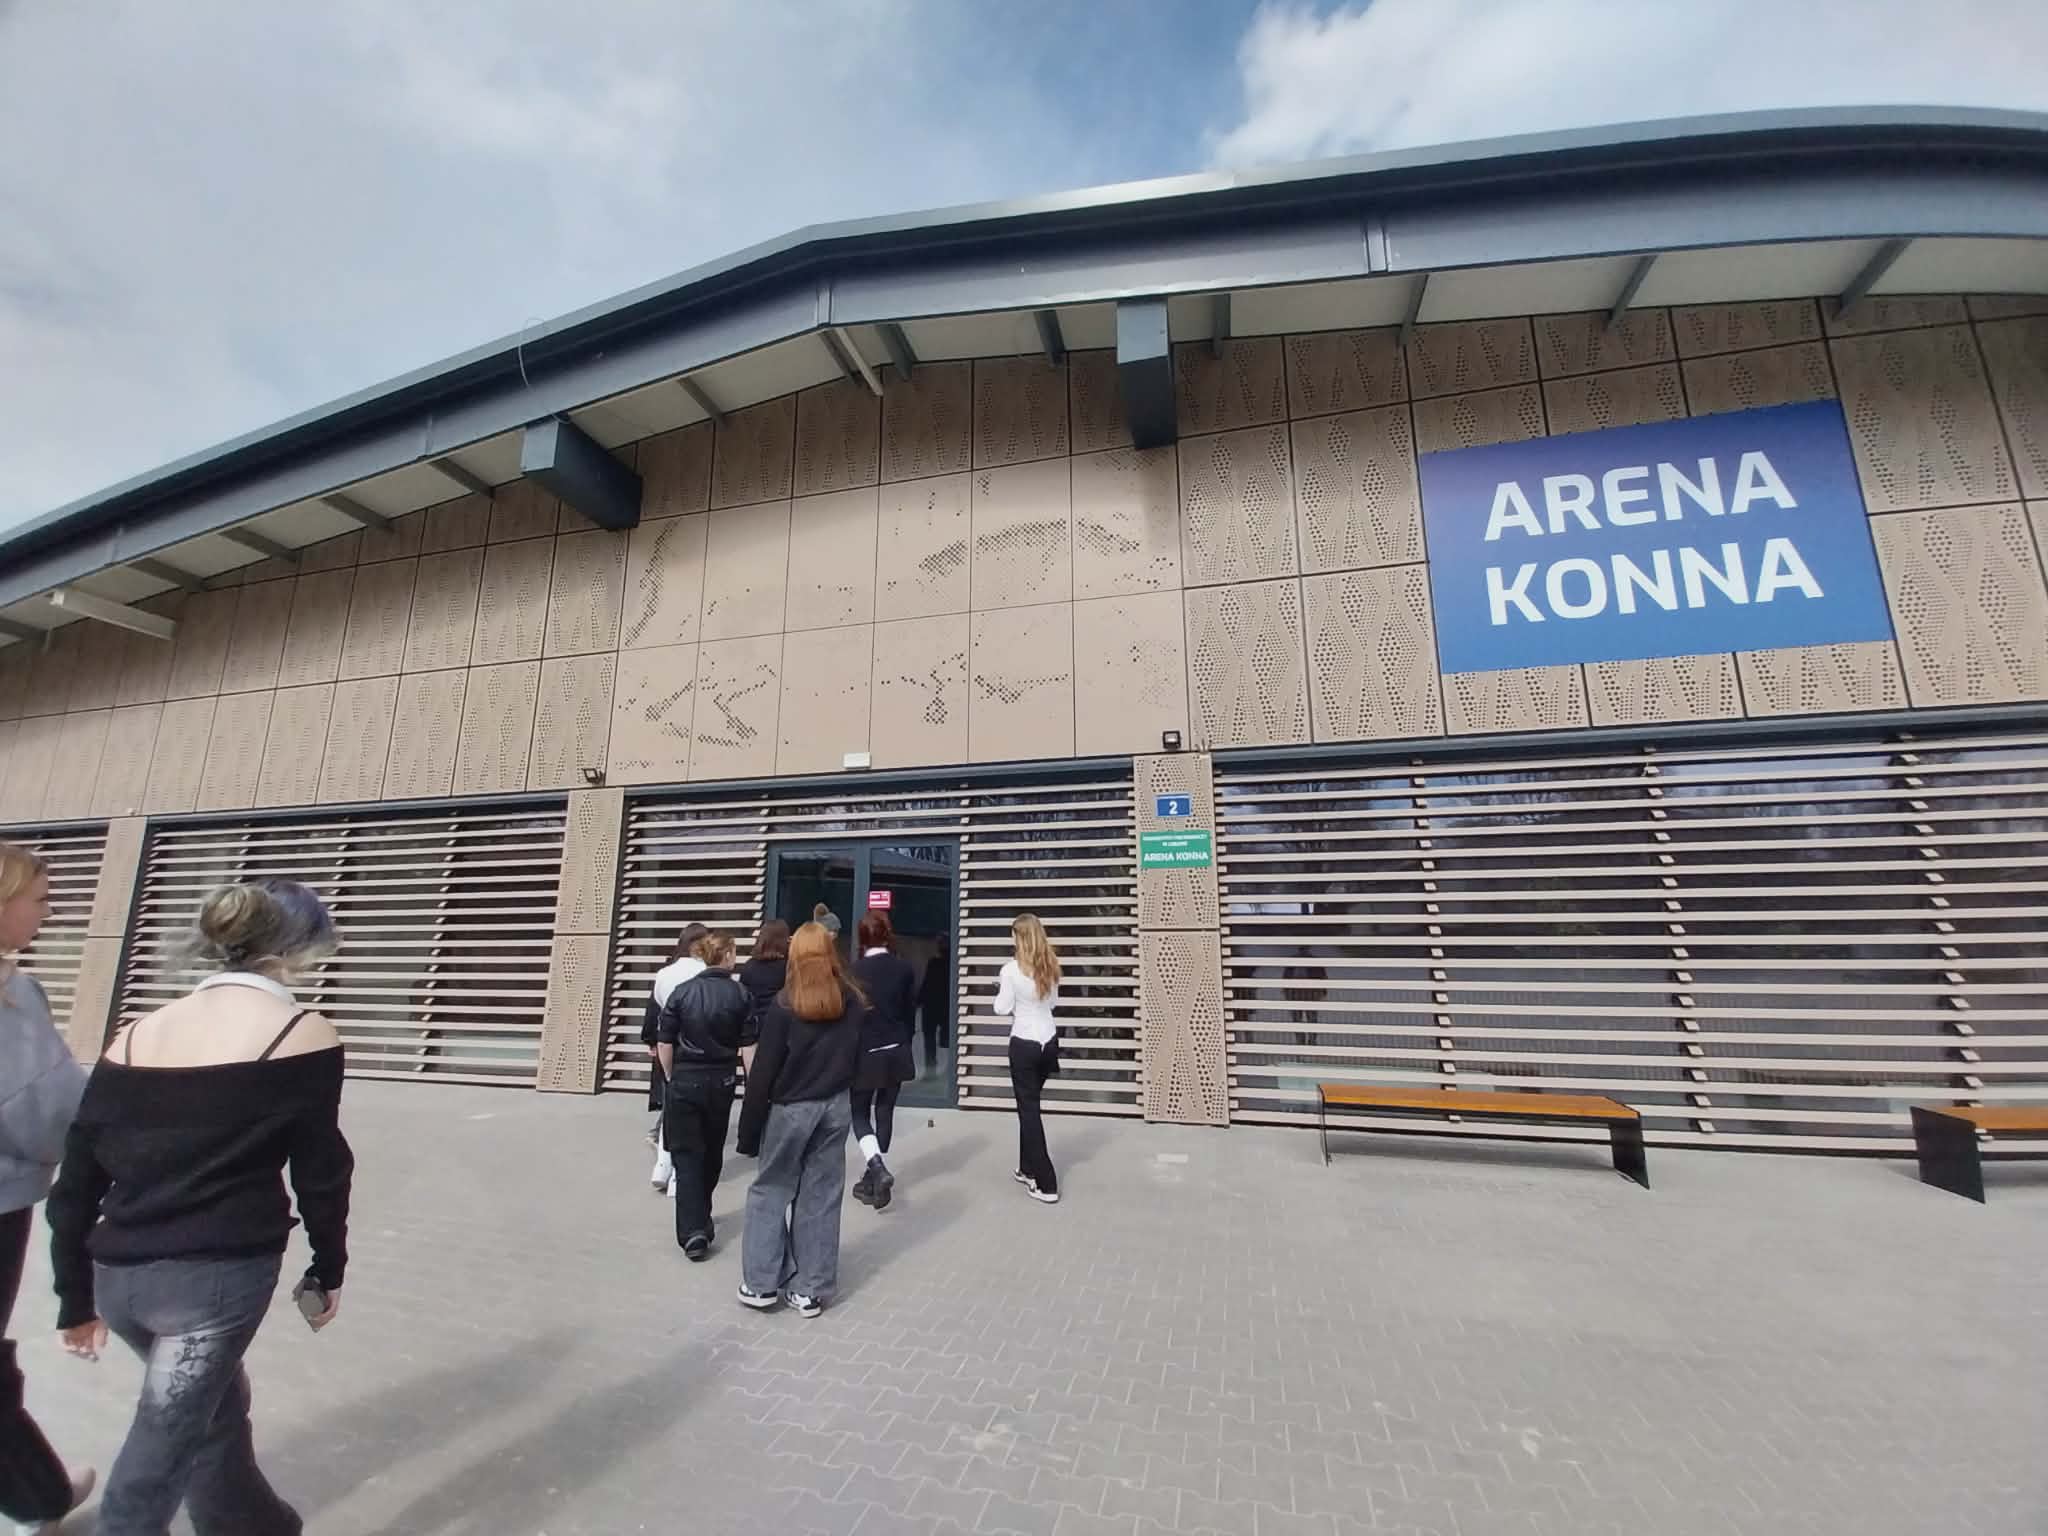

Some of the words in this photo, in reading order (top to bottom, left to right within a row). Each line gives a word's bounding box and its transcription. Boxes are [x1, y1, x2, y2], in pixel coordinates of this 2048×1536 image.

[1484, 450, 1798, 541] ARENA
[1486, 537, 1825, 626] KONNA
[1169, 801, 1178, 815] 2
[1143, 852, 1175, 862] ARENA
[1175, 851, 1209, 861] KONNA
